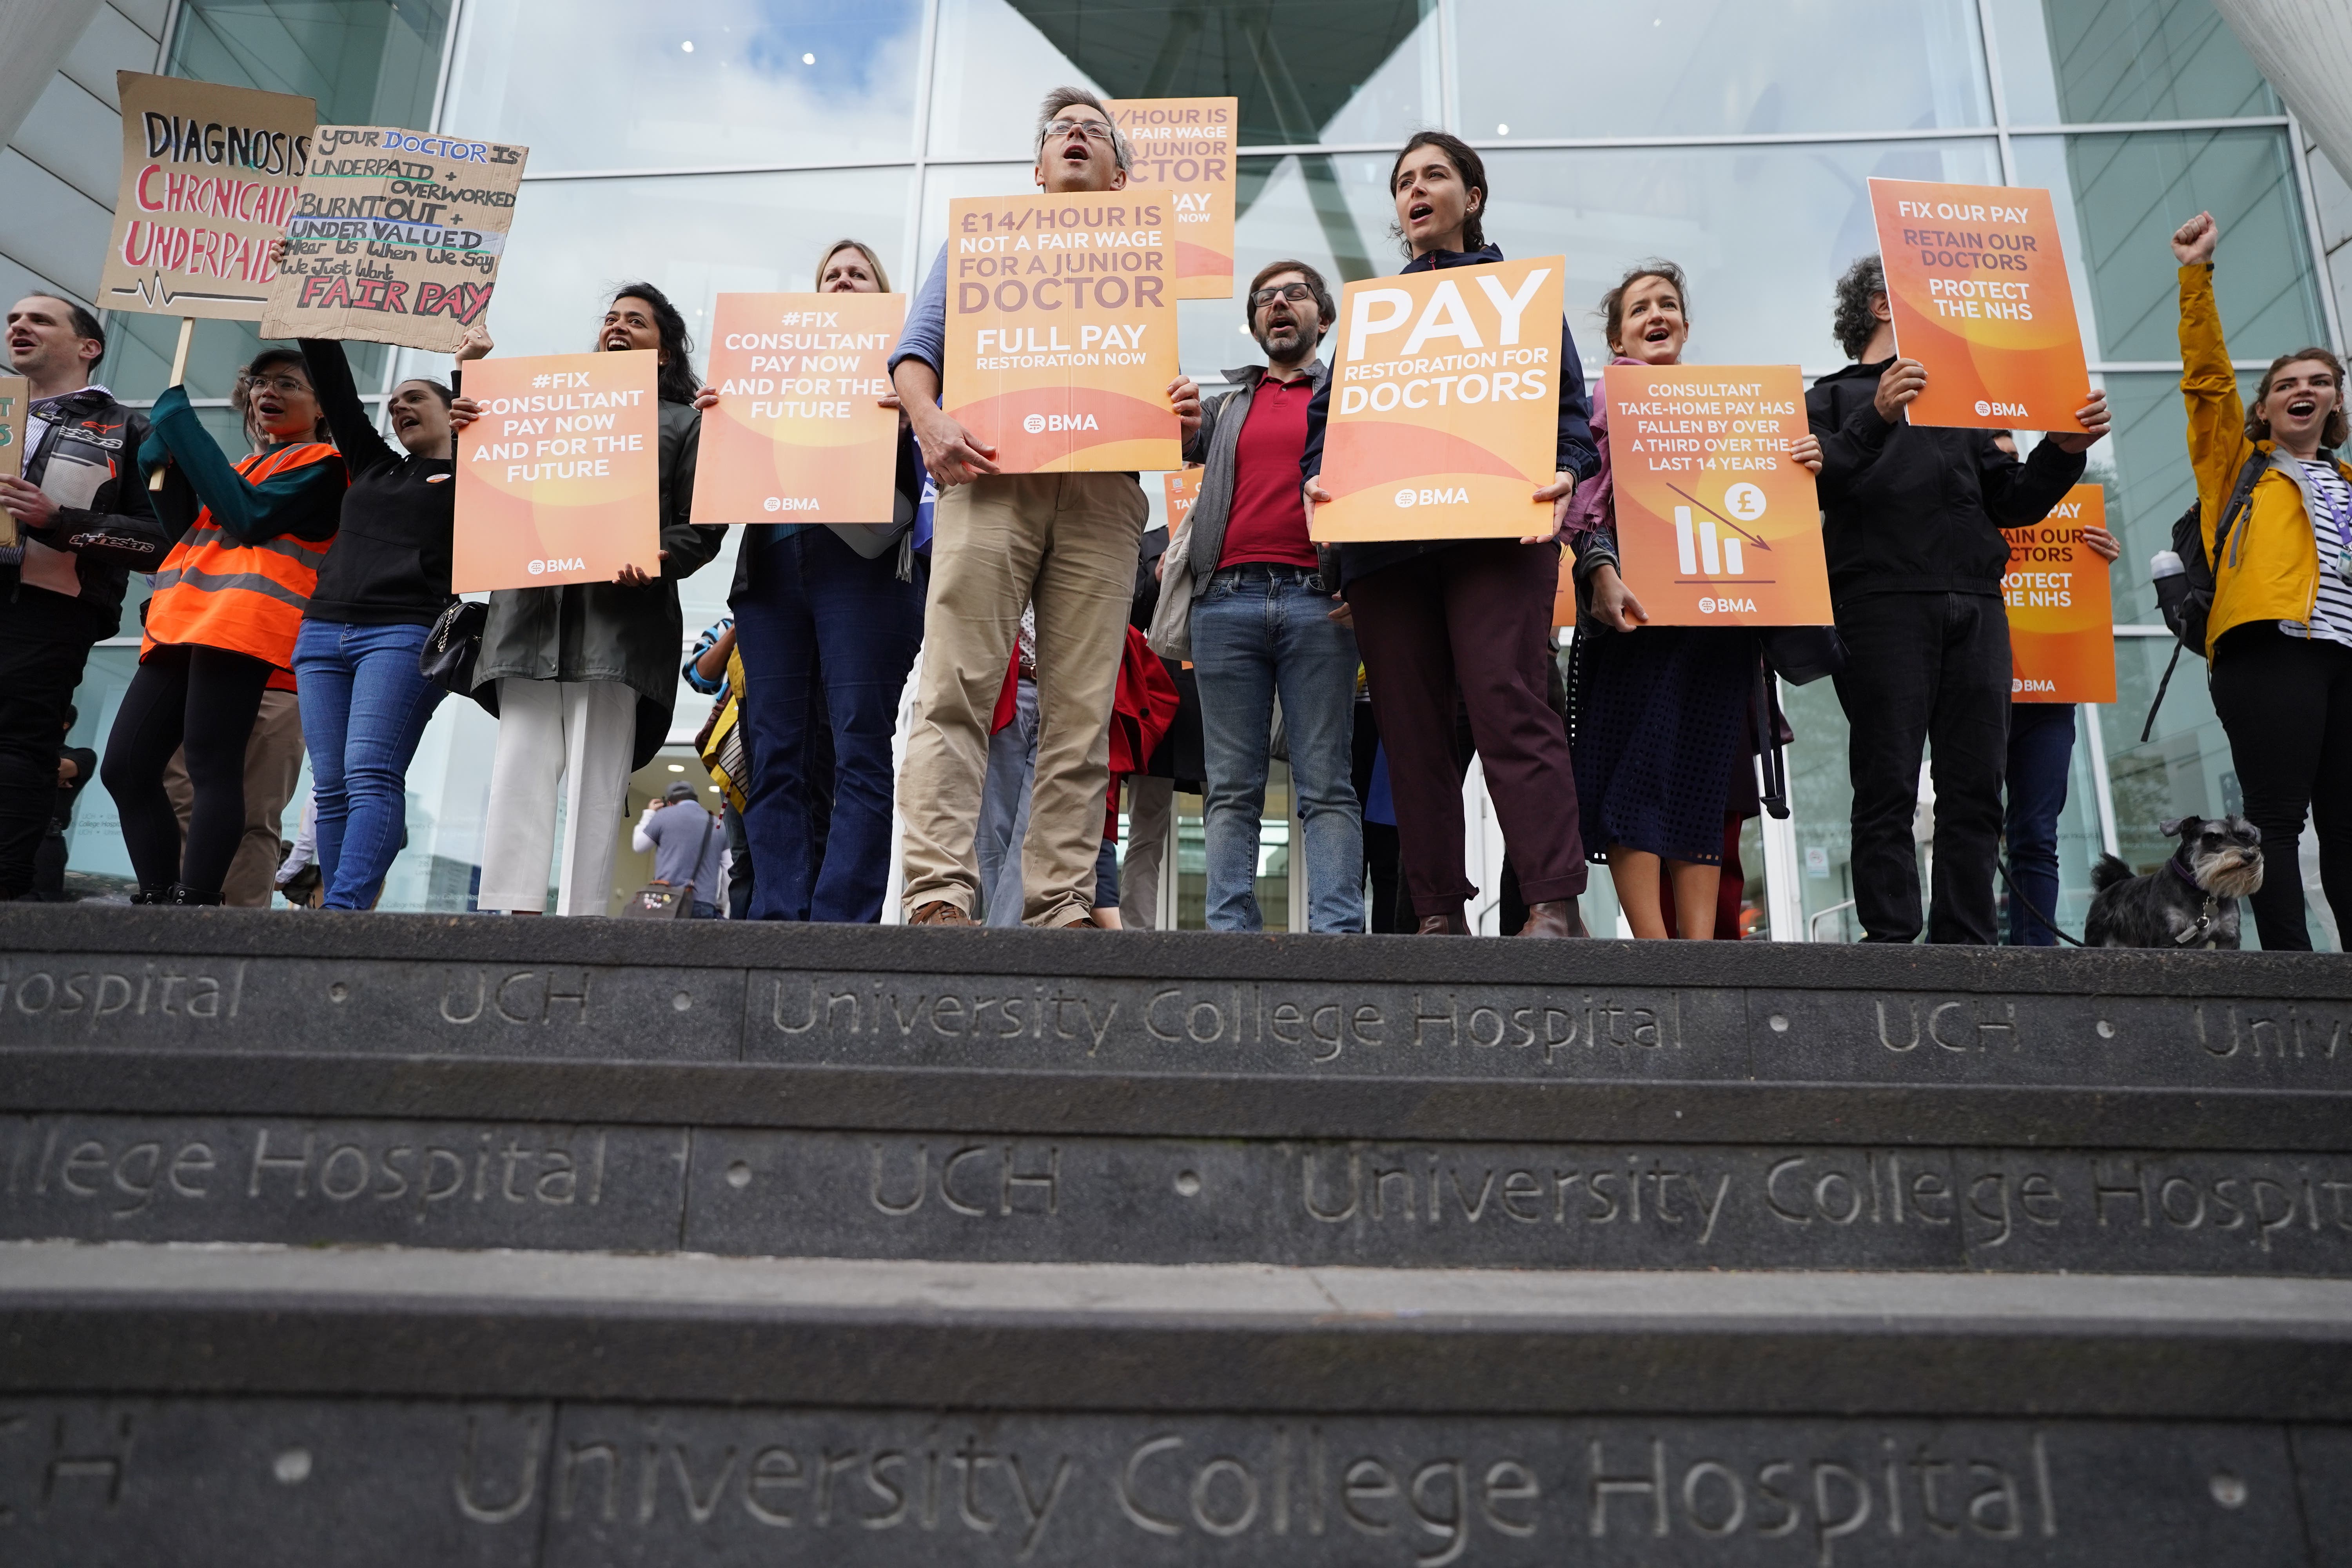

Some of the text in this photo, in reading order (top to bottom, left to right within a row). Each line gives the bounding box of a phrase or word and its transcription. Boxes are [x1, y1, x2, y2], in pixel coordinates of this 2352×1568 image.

[1208, 109, 1227, 123] IS
[1132, 128, 1171, 140] FAIR
[1175, 126, 1227, 139] WAGE
[142, 112, 312, 179] DIAGNOSIS
[381, 131, 488, 164] DOCTOR
[1143, 141, 1227, 159] JUNIOR
[312, 159, 434, 180] UNDERPAID
[391, 180, 515, 207] OVERWORKED
[961, 205, 1161, 233] £14/HOUR IS
[1178, 213, 1210, 223] NOW
[1898, 200, 2028, 224] FIX OUR PAY
[960, 230, 1163, 254] NOT A FAIR WAGE
[1903, 229, 2037, 252] RETAIN OUR
[122, 221, 277, 283] UNDERPAID
[285, 239, 495, 274] Hear Us When We Say
[1921, 250, 2028, 271] DOCTORS
[281, 258, 394, 280] We Just Want
[960, 252, 1163, 278] FOR A JUNIOR
[958, 276, 1165, 314] DOCTOR
[1929, 278, 2029, 300] PROTECT
[297, 275, 495, 326] FAIR PAY
[1933, 299, 2033, 321] THE NHS
[781, 312, 838, 328] #FIX
[1347, 268, 1552, 362] PAY
[725, 333, 890, 350] CONSULTANT
[977, 324, 1147, 354] FULL PAY
[750, 356, 860, 372] PAY NOW
[976, 352, 1146, 370] RESTORATION NOW
[1344, 347, 1549, 381] RESTORATION FOR
[532, 371, 590, 389] #FIX
[719, 378, 886, 395] AND FOR THE
[1648, 383, 1762, 397] CONSULTANT
[477, 390, 644, 416] CONSULTANT
[1340, 369, 1546, 415] DOCTORS
[751, 401, 851, 418] FUTURE
[1618, 401, 1795, 416] TAKE-HOME PAY HAS
[1993, 402, 2029, 417] BMA
[503, 414, 615, 437] PAY NOW
[1049, 413, 1099, 432] BMA
[1638, 420, 1780, 434] FALLEN BY OVER
[472, 434, 643, 462] AND FOR THE
[1631, 438, 1790, 452] A THIRD OVER THE
[507, 459, 610, 482] FUTURE
[1649, 457, 1777, 470] LAST 14 YEARS
[782, 497, 820, 510] BMA
[1419, 487, 1469, 506] BMA
[1737, 490, 1755, 513] £
[2041, 529, 2084, 544] OUR
[546, 557, 586, 573] BMA
[1718, 598, 1757, 612] BMA
[2029, 591, 2072, 607] NHS
[2024, 679, 2056, 692] BMA
[0, 959, 247, 1034] ospital
[439, 969, 591, 1025] UCH
[773, 978, 1682, 1065] University College Hospital
[1875, 999, 2020, 1053] UCH
[2194, 1004, 2352, 1058] Univ
[248, 1127, 606, 1224] Hospital
[870, 1143, 1060, 1216] UCH
[1302, 1152, 1730, 1246] University
[1765, 1150, 2062, 1248] College
[455, 1414, 2057, 1568] University College Hospital
